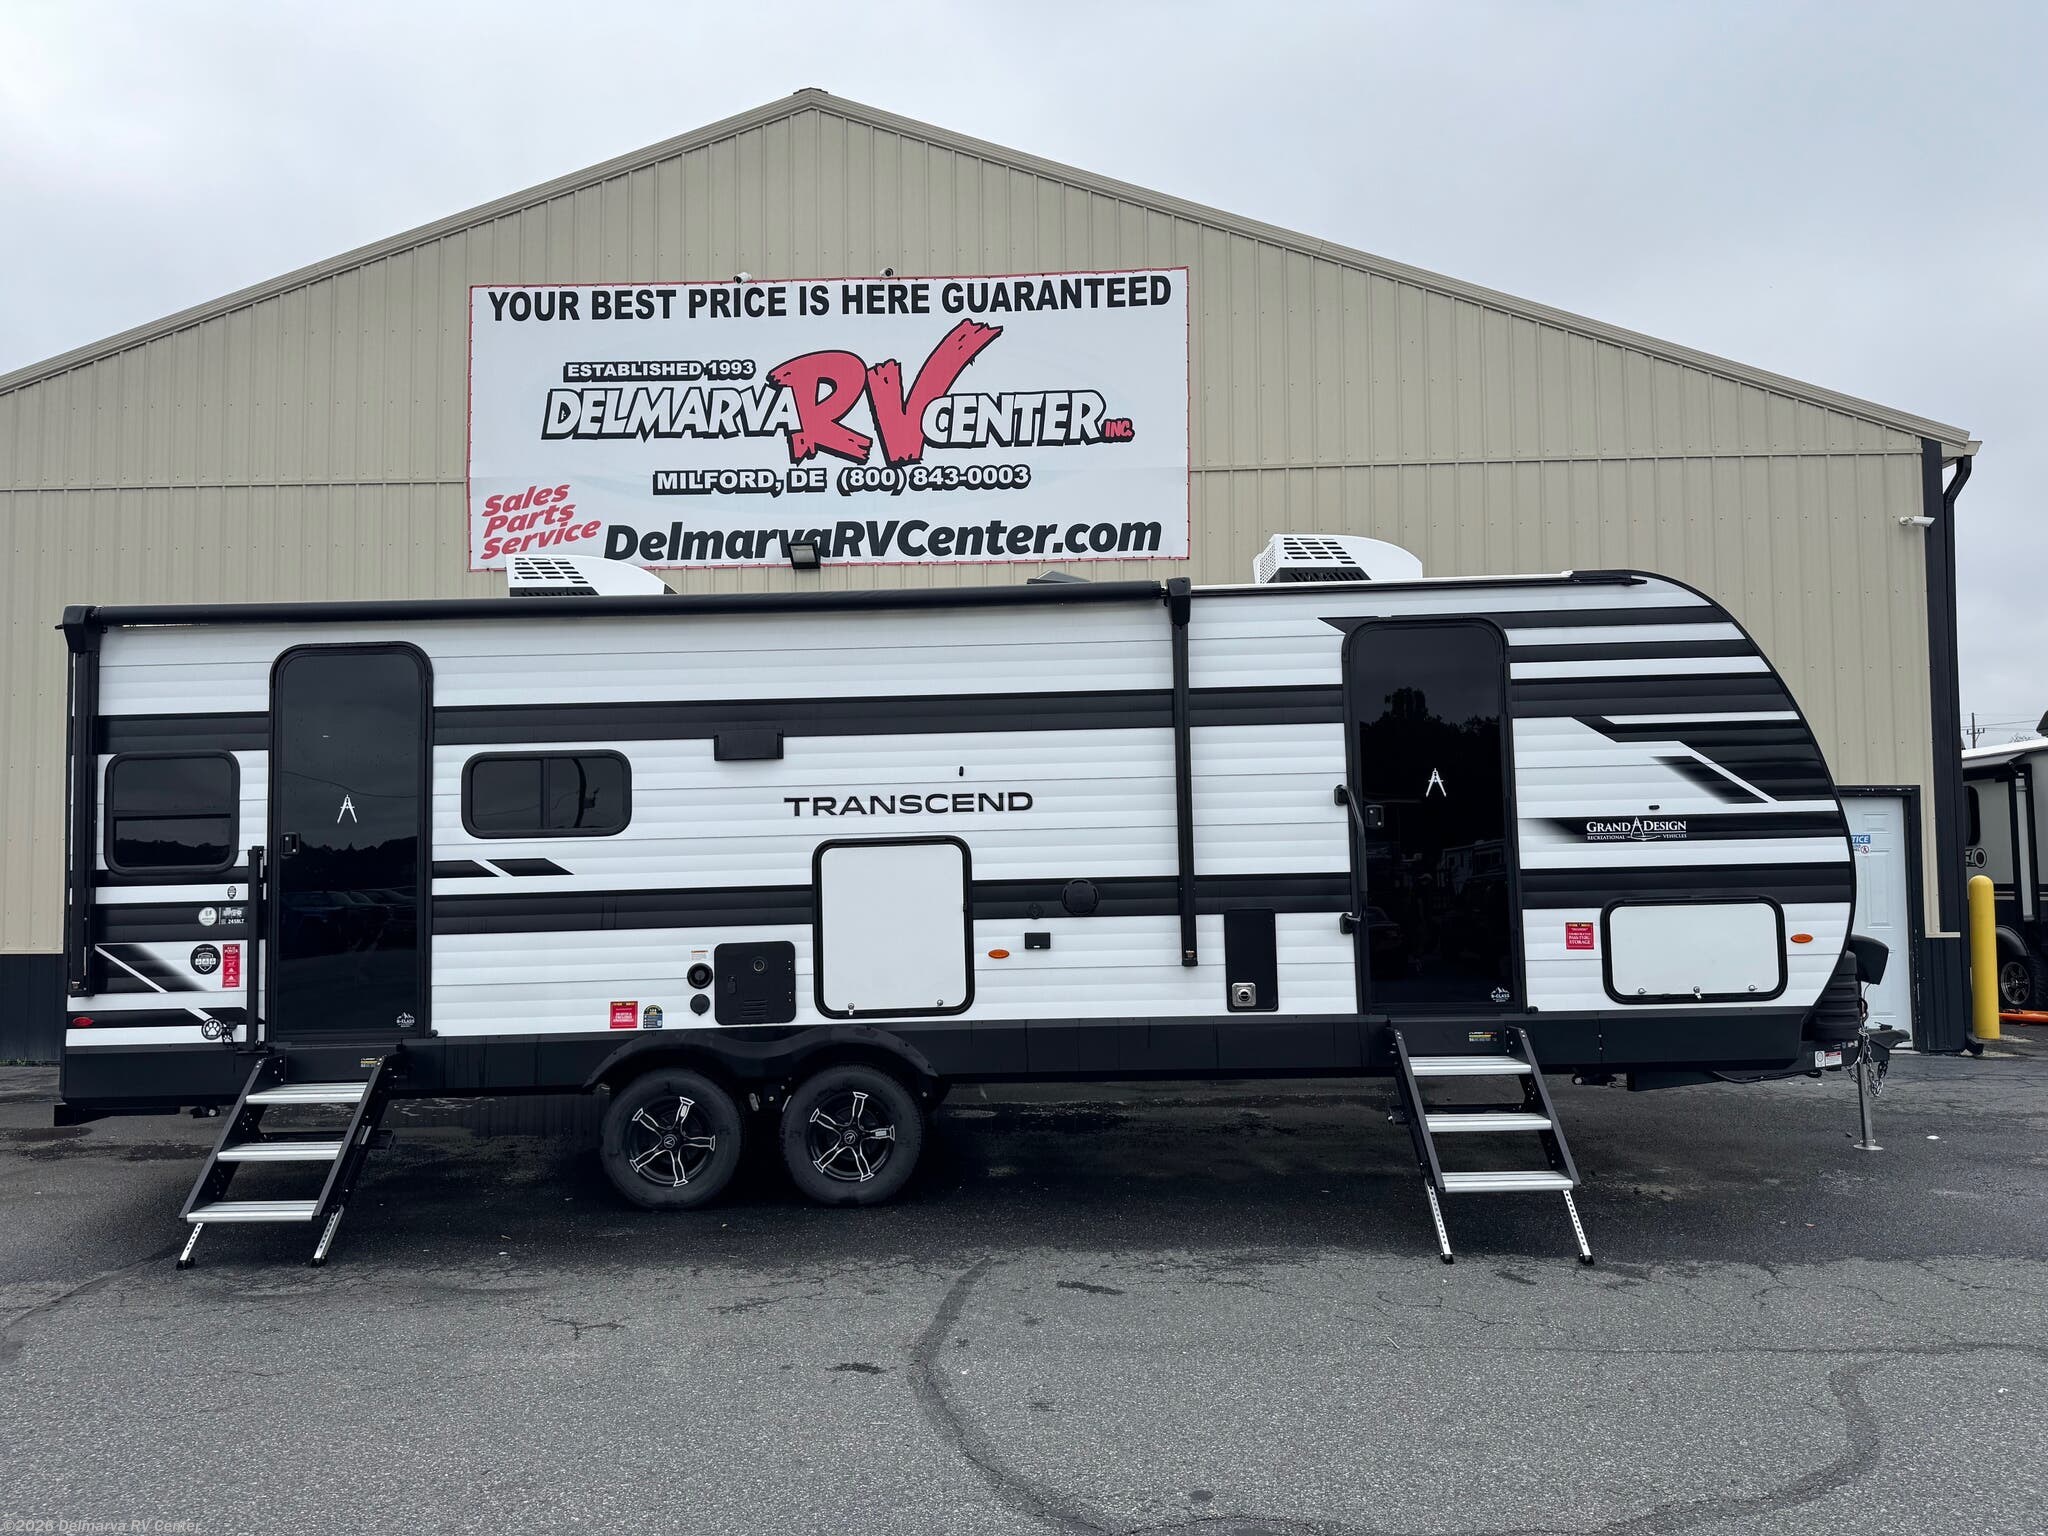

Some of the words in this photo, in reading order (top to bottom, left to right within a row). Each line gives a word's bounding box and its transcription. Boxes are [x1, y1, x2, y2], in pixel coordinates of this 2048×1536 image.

[489, 291, 580, 322] YOUR
[591, 289, 677, 320] BEST
[689, 286, 786, 318] PRICE
[799, 285, 830, 316] IS
[841, 283, 930, 315] HERE
[941, 275, 1172, 314] GUARANTEED
[566, 361, 703, 380] ESTABLISHED
[707, 360, 755, 379] 1993
[542, 386, 803, 441] DELMARVA
[766, 318, 1004, 467] RV
[921, 390, 1106, 448] CENTER
[1104, 418, 1135, 442] INC.
[655, 469, 784, 497] MILFORD,
[788, 468, 827, 491] DE
[837, 467, 906, 496] (800)
[909, 465, 1031, 491] 843-0003
[481, 484, 571, 517] Sales
[483, 502, 576, 538] Parts
[480, 519, 602, 560] Service
[604, 520, 1162, 561] DelmarvaRVCenter.com
[784, 792, 1034, 817] TRANSCEND
[1586, 821, 1631, 832] GRAND
[1643, 820, 1687, 831] DESIGN
